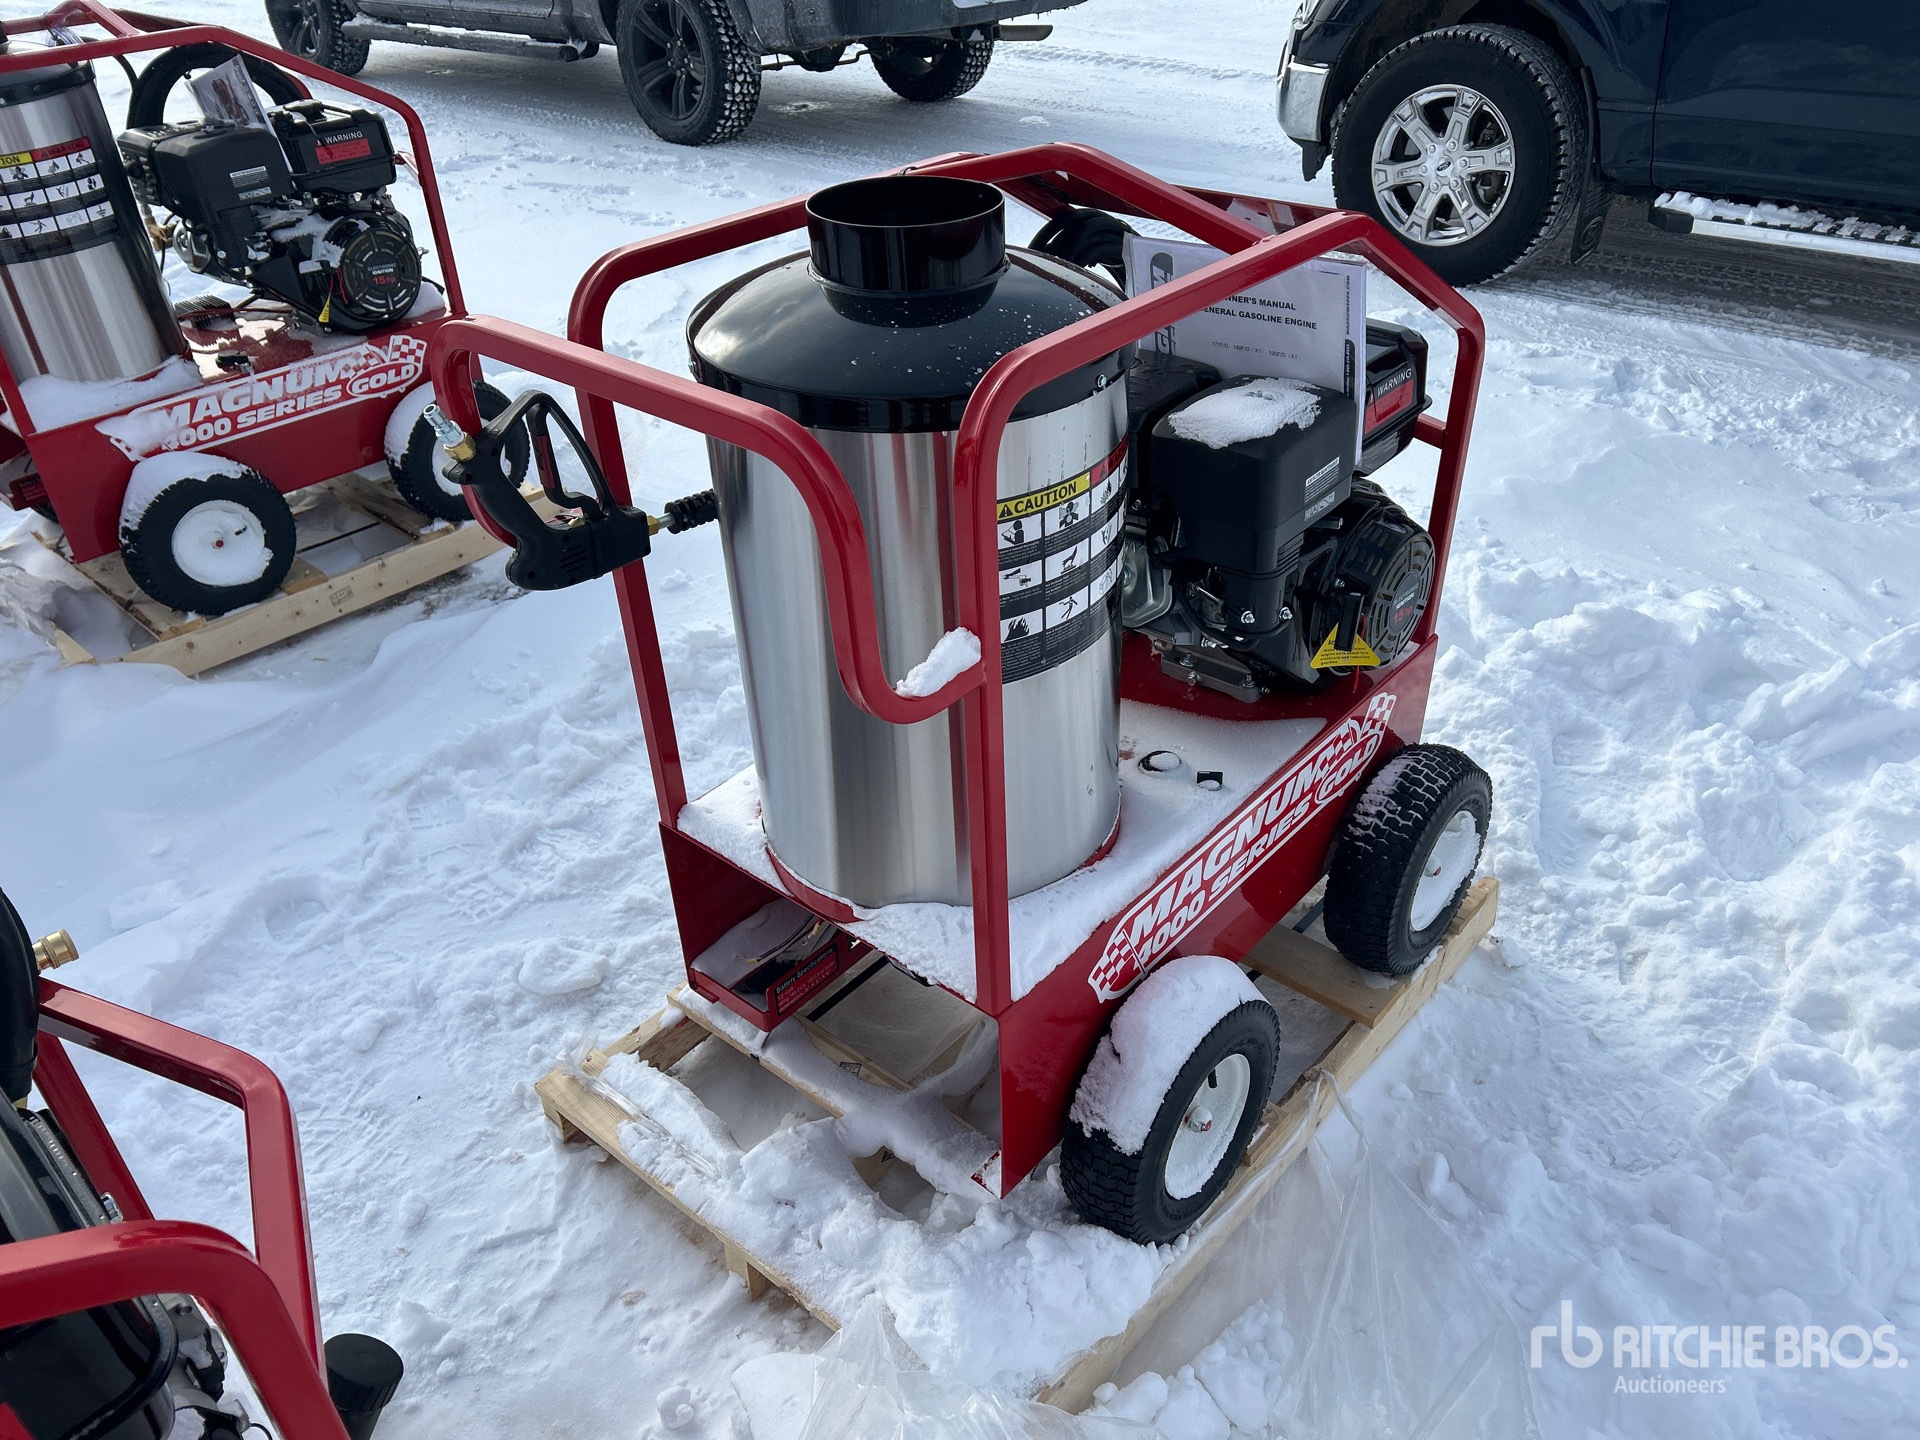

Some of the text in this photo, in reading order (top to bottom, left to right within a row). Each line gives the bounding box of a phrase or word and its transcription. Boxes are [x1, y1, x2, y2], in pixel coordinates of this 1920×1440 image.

[324, 130, 363, 144] WARNING
[0, 156, 21, 166] ION
[1226, 294, 1296, 311] NER'S MANUAL
[1200, 306, 1317, 330] ENERAL GASOLINE ENGINE
[1376, 367, 1412, 397] WARNING
[236, 384, 342, 430] SERIES
[351, 364, 415, 395] GOLD
[1013, 480, 1077, 514] CAUTION
[1129, 744, 1335, 947] MAGNUM
[1134, 739, 1374, 970] 4000 SERIES GOLD
[776, 976, 796, 995] Battery
